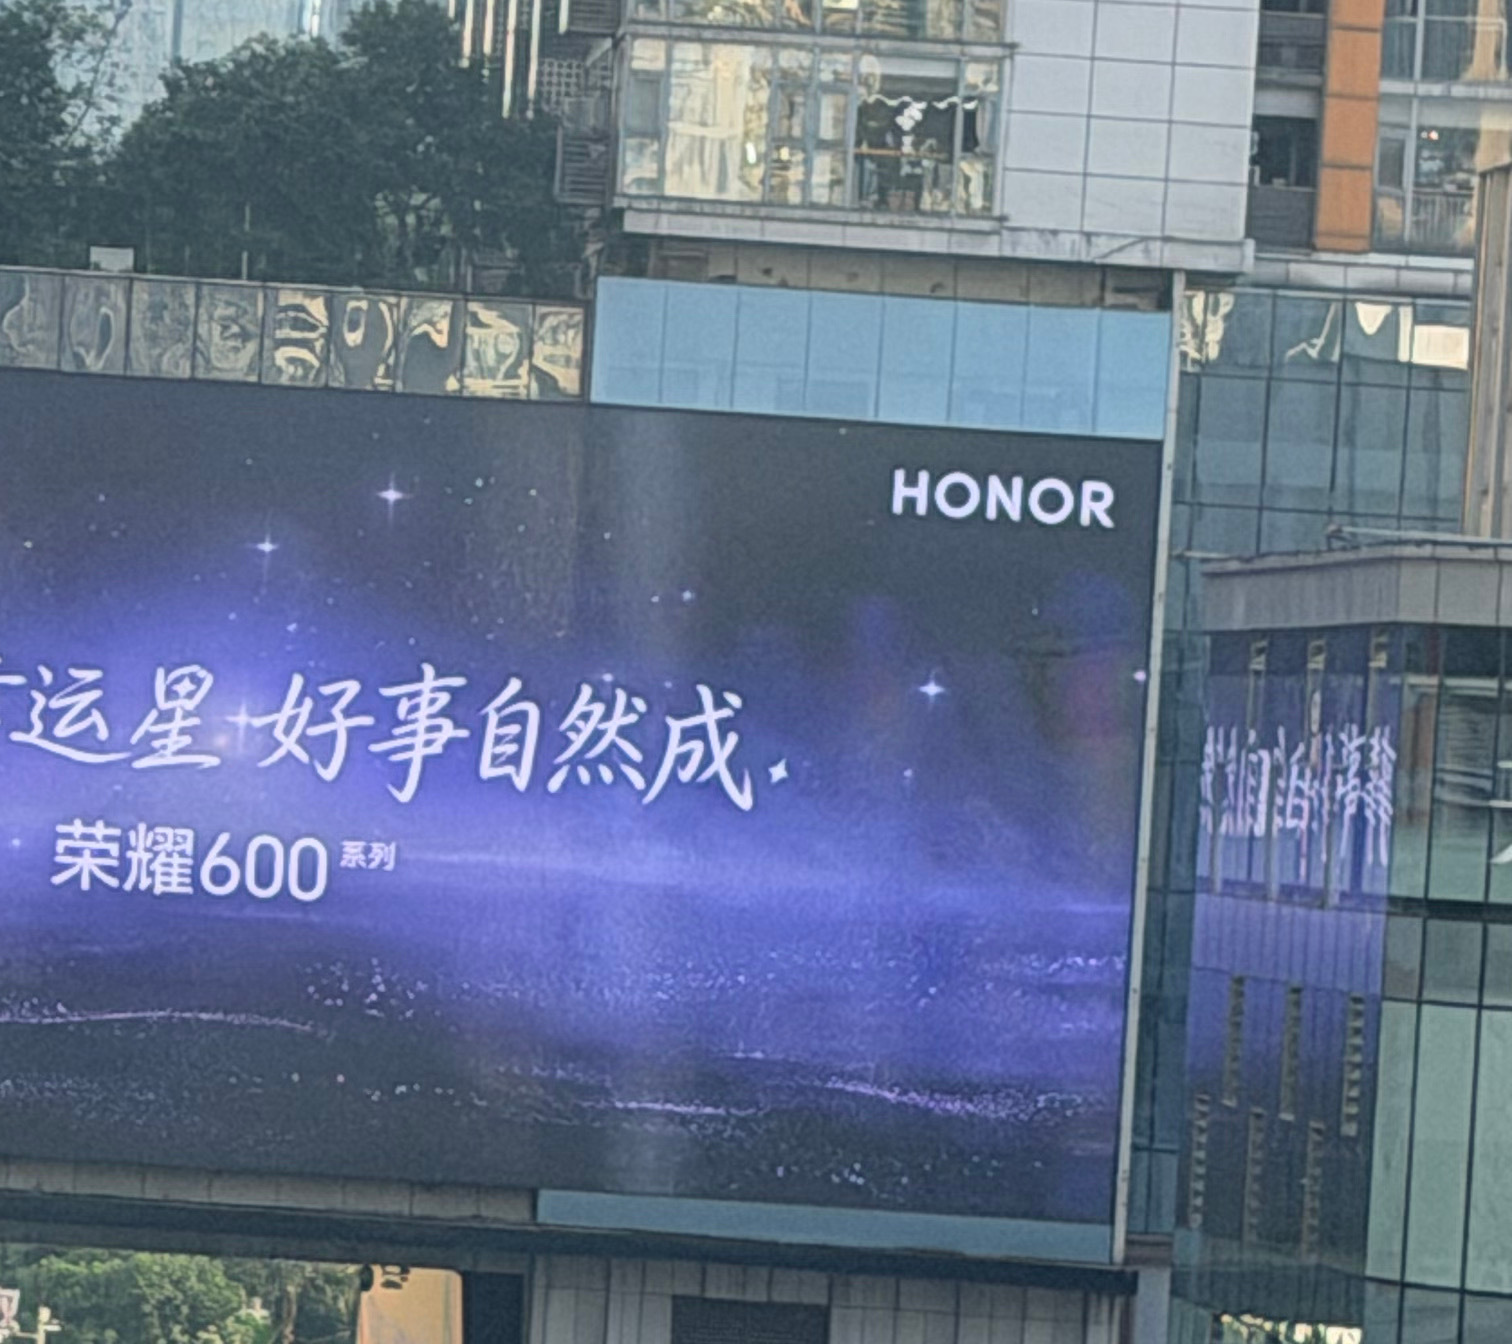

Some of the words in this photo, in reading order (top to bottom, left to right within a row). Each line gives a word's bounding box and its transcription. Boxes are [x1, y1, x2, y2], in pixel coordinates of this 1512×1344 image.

[891, 467, 1116, 529] HONOR
[250, 662, 754, 812] 好事自然成
[50, 818, 329, 903] 荣耀600
[339, 839, 398, 872] 系列
